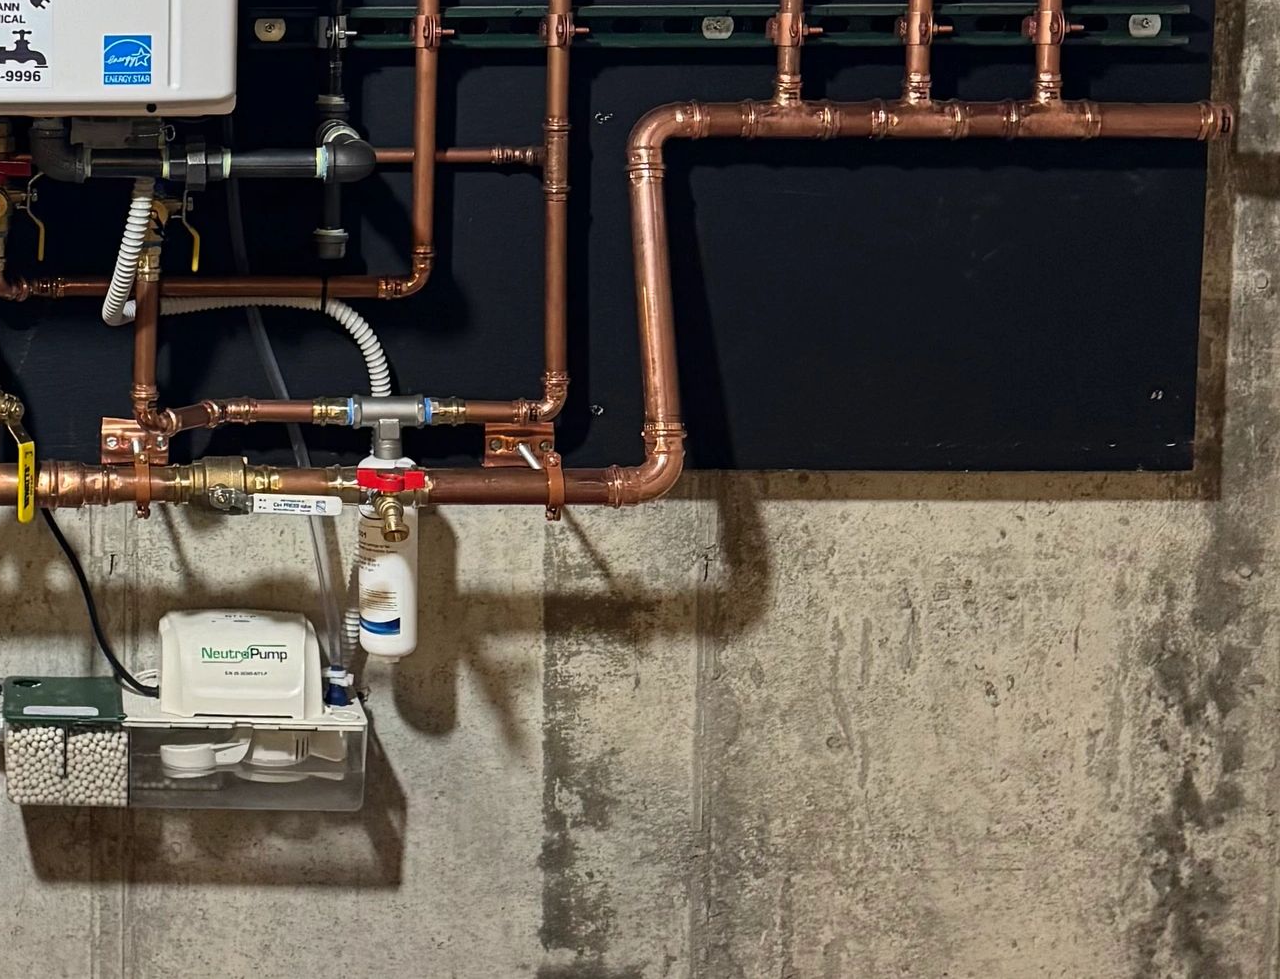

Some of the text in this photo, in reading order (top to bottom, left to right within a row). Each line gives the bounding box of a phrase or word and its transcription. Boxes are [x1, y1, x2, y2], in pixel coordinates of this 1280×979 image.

[105, 75, 150, 83] ENERGY STAR
[201, 647, 288, 662] NeutraPump
